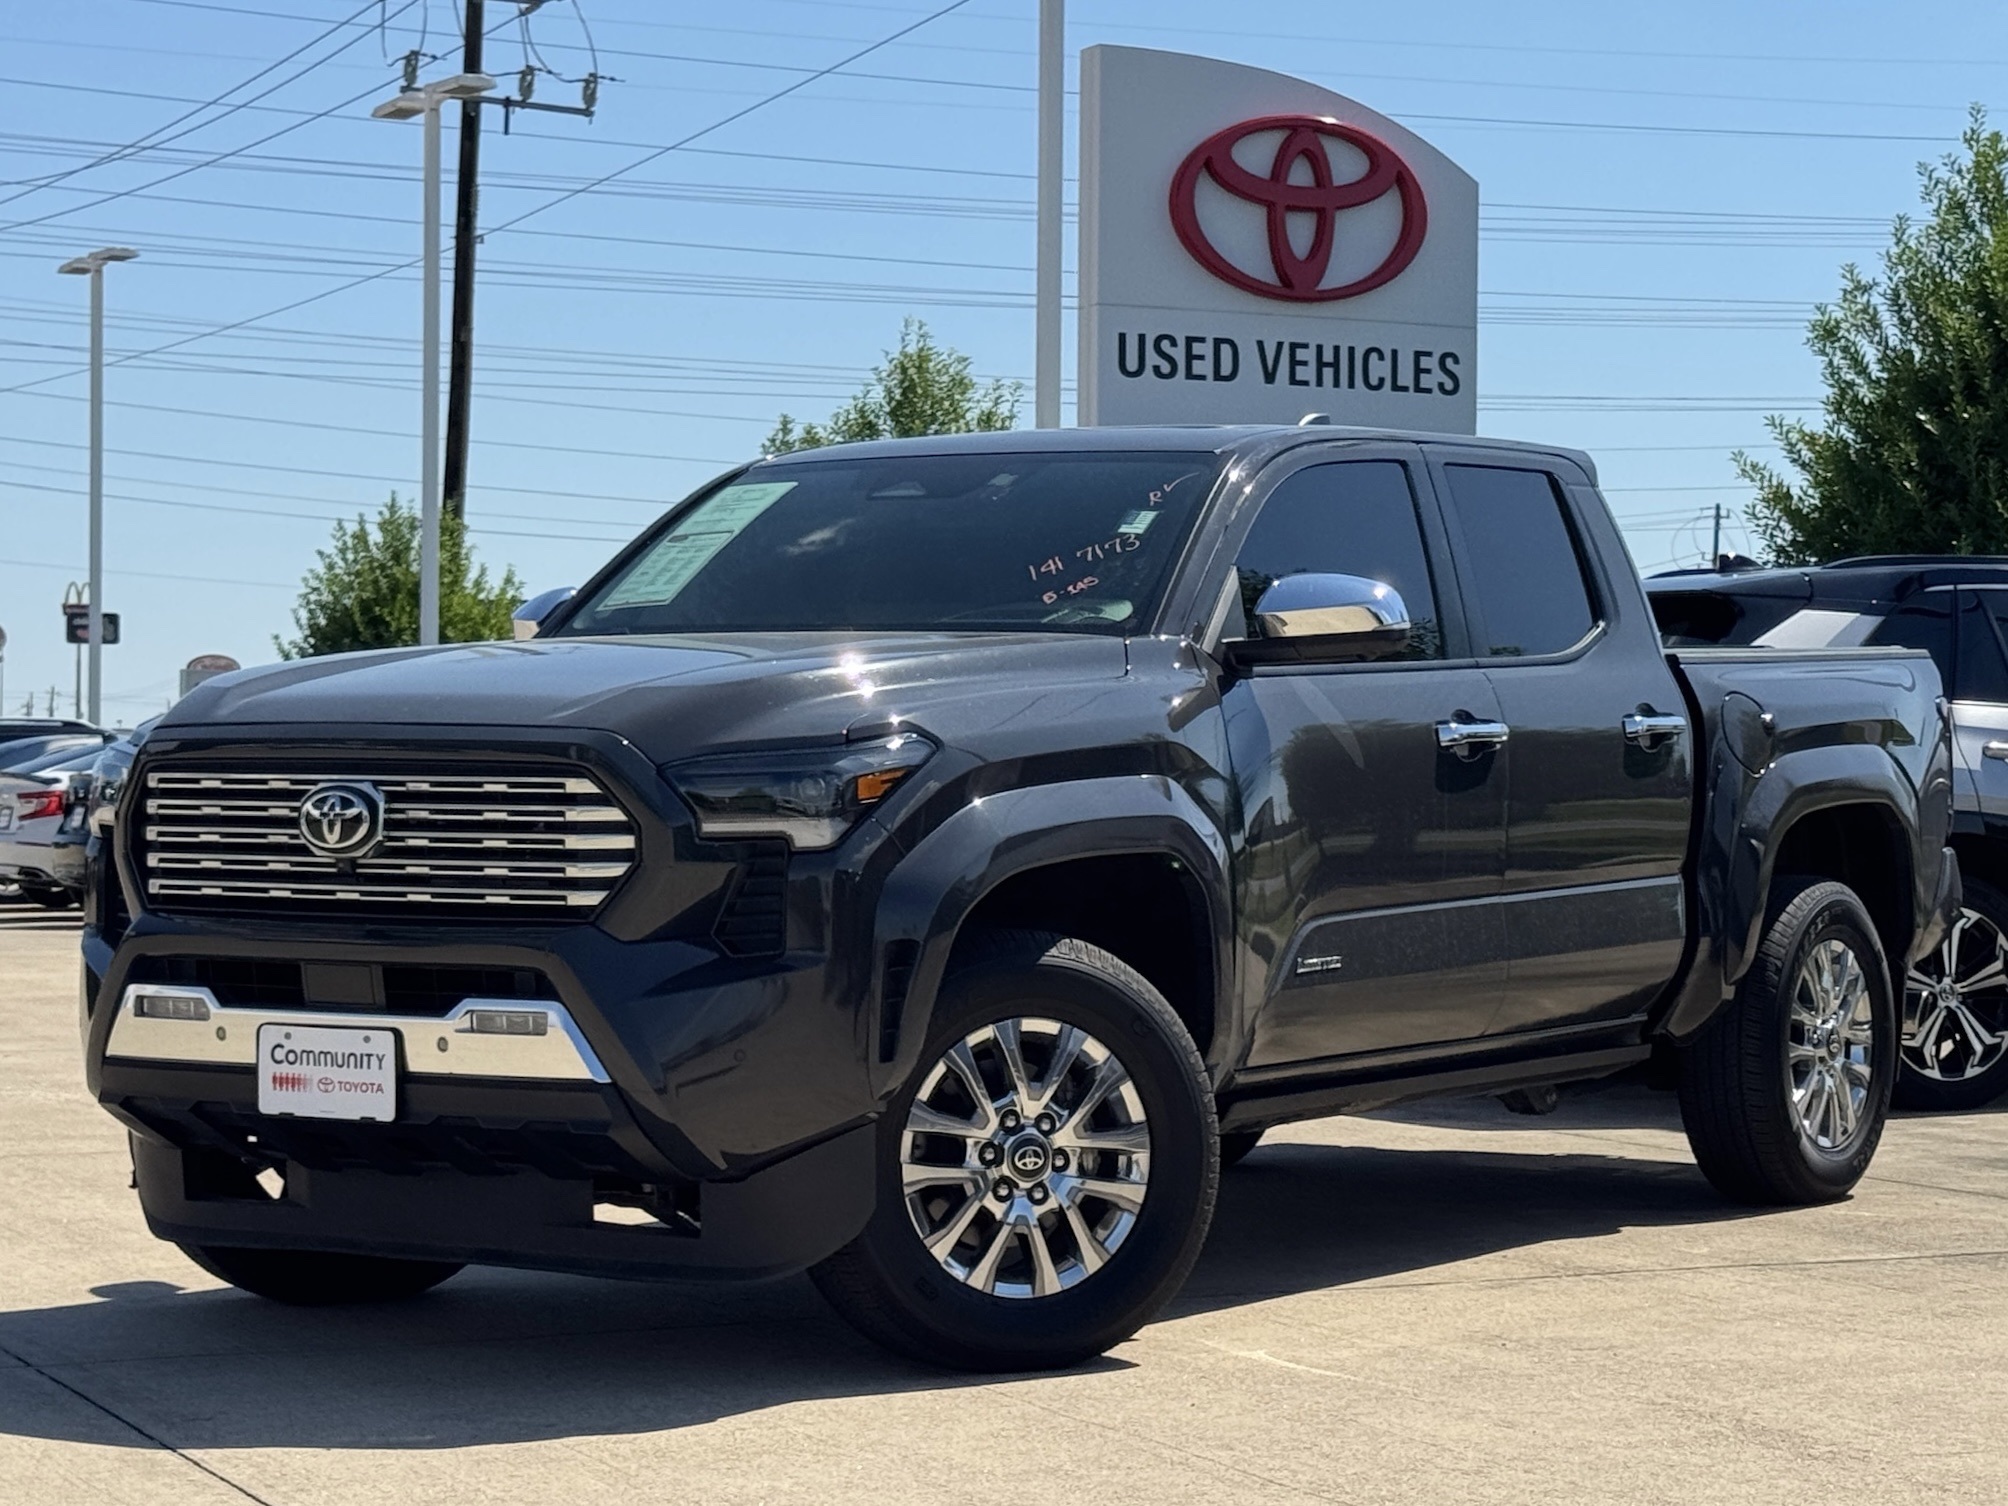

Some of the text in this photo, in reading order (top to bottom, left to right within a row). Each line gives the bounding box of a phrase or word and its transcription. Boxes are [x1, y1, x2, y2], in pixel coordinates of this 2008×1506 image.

[1117, 331, 1462, 397] USED VEHICLES
[336, 1080, 384, 1095] TOYOTA
